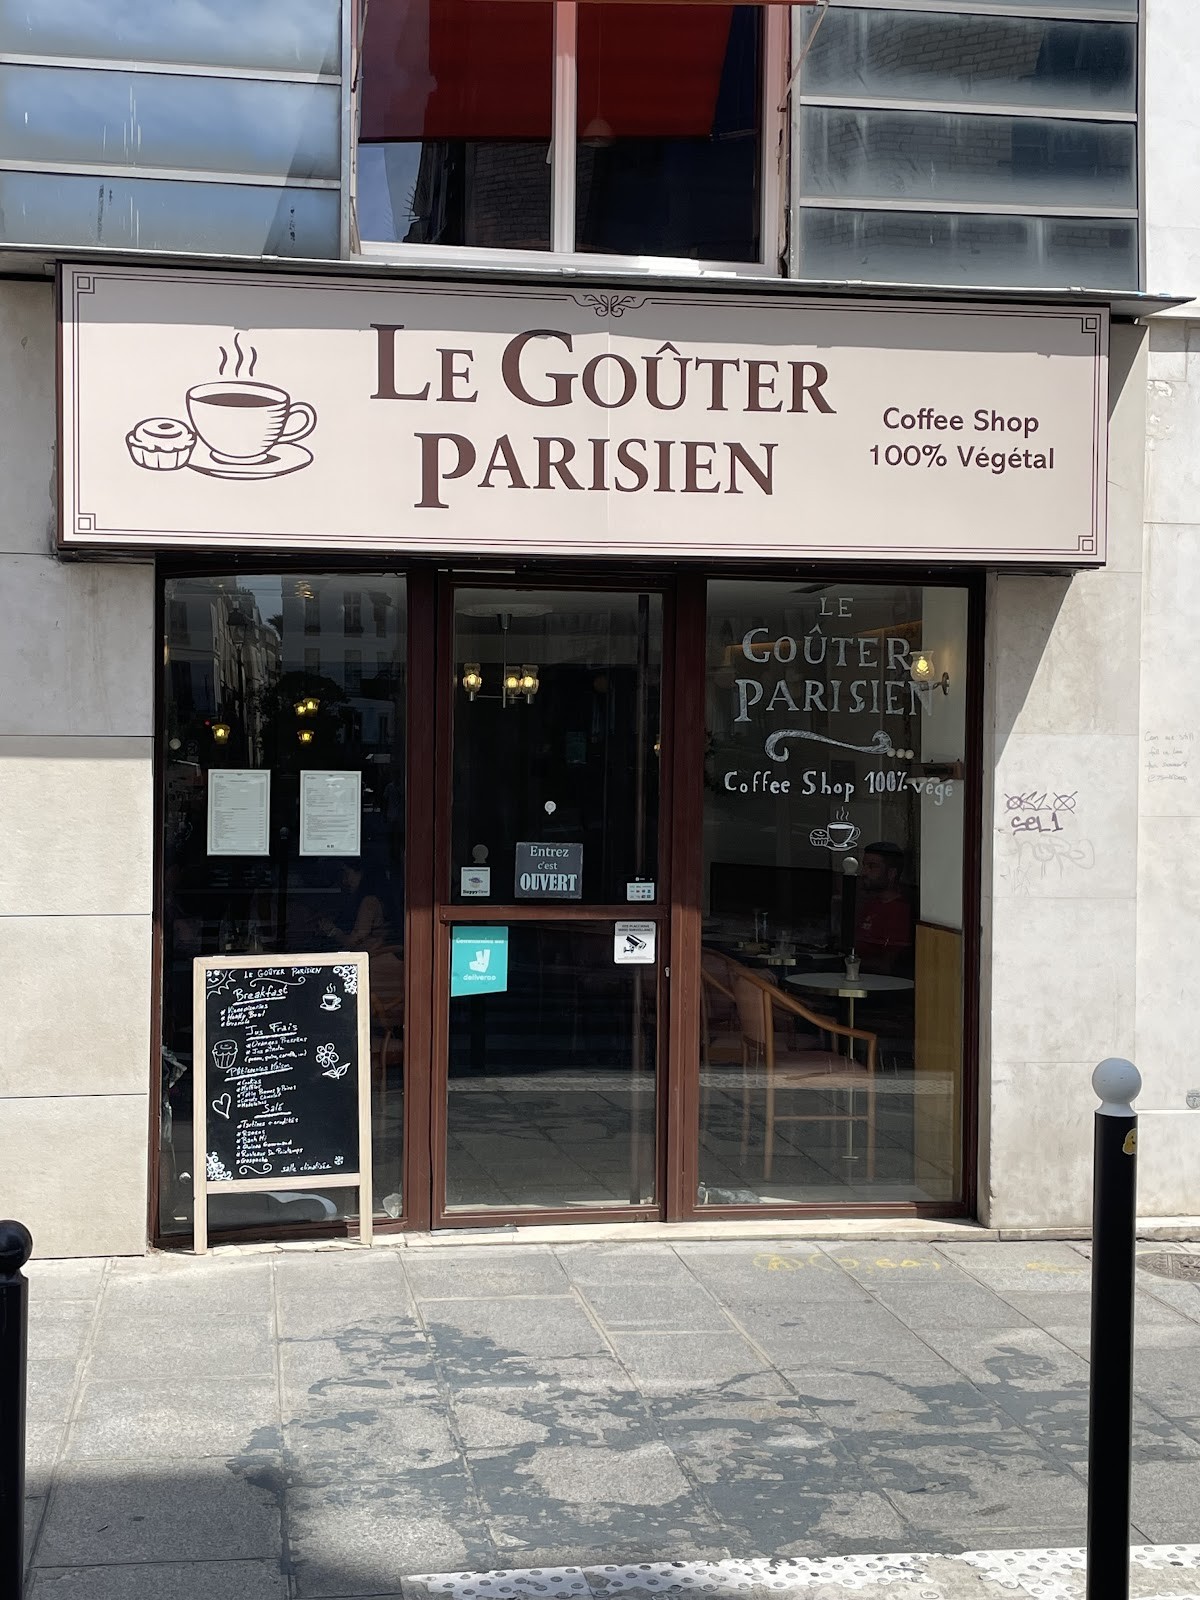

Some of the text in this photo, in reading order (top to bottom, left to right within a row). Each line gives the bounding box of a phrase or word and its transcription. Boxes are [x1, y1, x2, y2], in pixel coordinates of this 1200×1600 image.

[370, 323, 837, 415] LE GOÛTER
[883, 406, 1039, 439] Coffee Shop
[414, 432, 778, 509] PARISIEN
[869, 444, 1055, 475] 100% Végétal
[818, 596, 854, 618] LE
[741, 623, 913, 671] GOÛTER
[734, 678, 942, 722] PARISIEN
[724, 770, 954, 806] Coffee Shop 100% végé
[529, 846, 570, 858] Entrez
[537, 861, 558, 871] c'est
[519, 873, 578, 892] OUVERT
[462, 973, 497, 981] deliveroo
[233, 985, 288, 1001] Breakfast
[245, 1021, 299, 1036] Jus Frais
[261, 1102, 285, 1114] Salé
